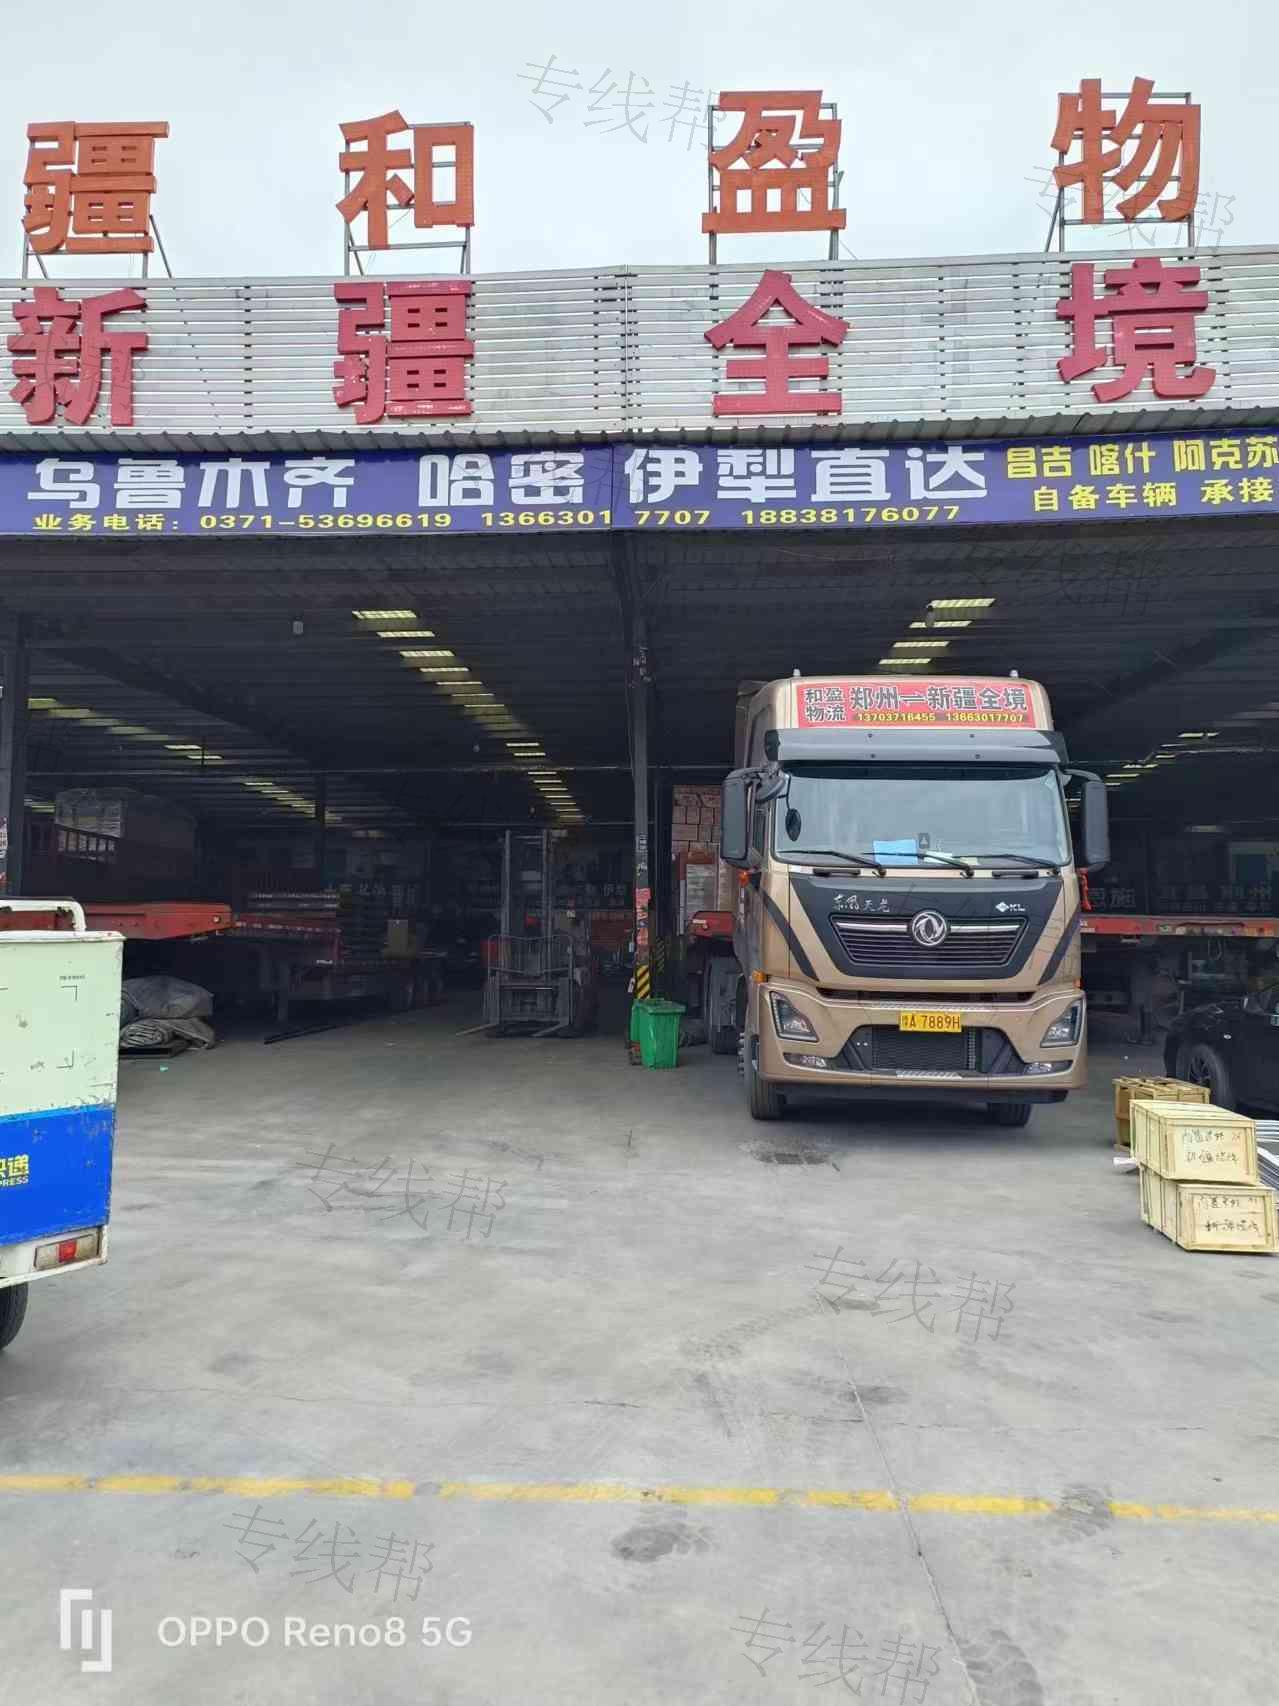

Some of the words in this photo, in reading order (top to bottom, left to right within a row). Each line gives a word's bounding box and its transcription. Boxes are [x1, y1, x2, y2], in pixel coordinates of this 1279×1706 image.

[1007, 446, 1073, 479] 昌吉
[1089, 441, 1157, 476] 喀什
[1173, 436, 1279, 473] 阿克苏
[27, 457, 356, 509] 乌鲁木齐
[417, 450, 585, 508] 哈密
[624, 446, 988, 505] 伊犁直达
[1033, 481, 1178, 512] 自备车辆
[1200, 476, 1275, 505] 承接
[200, 512, 452, 530] 0371-53696619
[741, 506, 960, 526] 18838176077
[804, 687, 844, 704] 和盈
[804, 705, 846, 722] 物流
